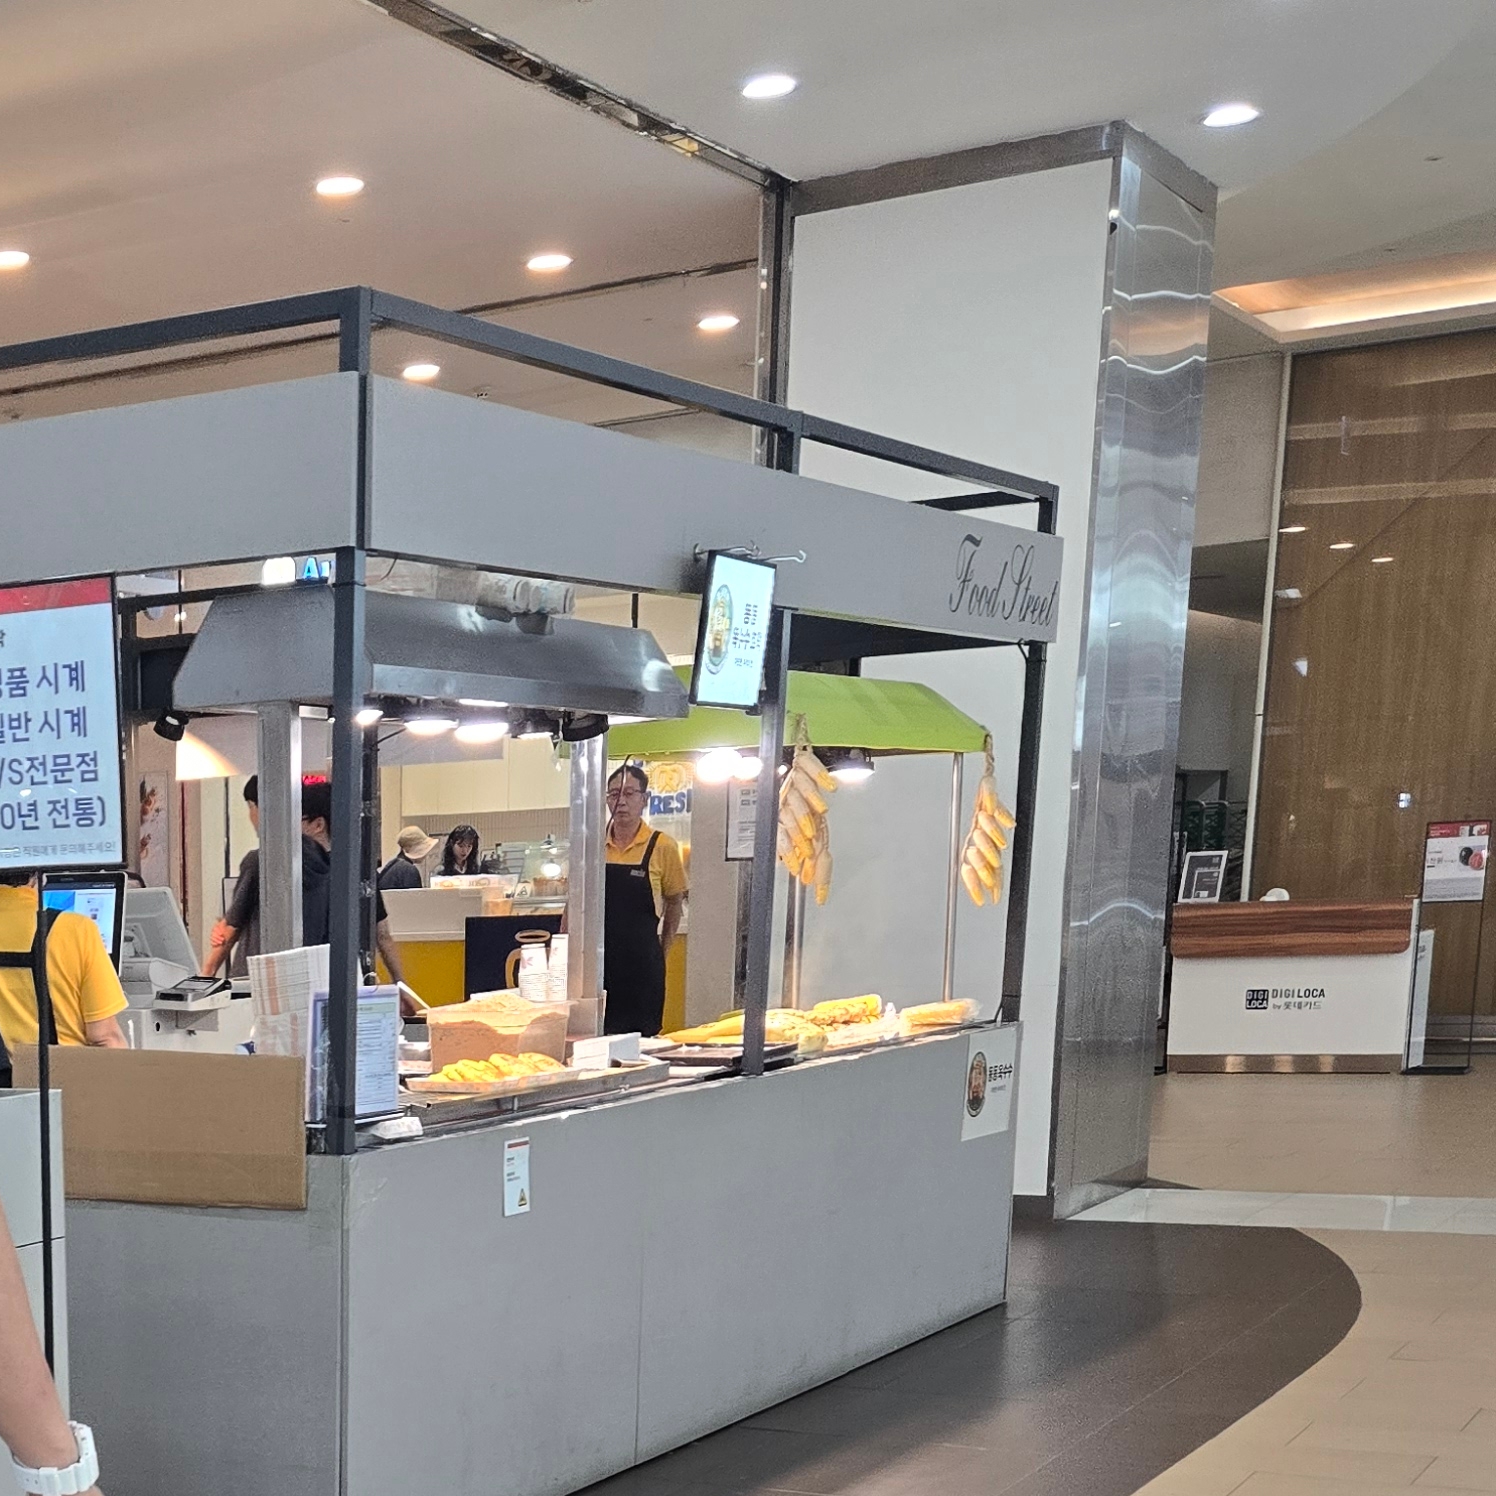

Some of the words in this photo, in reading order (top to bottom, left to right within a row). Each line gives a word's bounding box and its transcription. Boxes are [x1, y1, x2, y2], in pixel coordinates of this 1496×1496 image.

[949, 534, 1008, 617] Food
[1002, 545, 1058, 626] Street
[36, 660, 86, 695] 시계
[38, 706, 88, 740] 시계
[47, 795, 106, 829] 전통)
[1246, 991, 1268, 999] DIGI
[1246, 1000, 1268, 1008] LOCA
[1272, 988, 1295, 999] DIGI
[1297, 988, 1325, 998] LOCA
